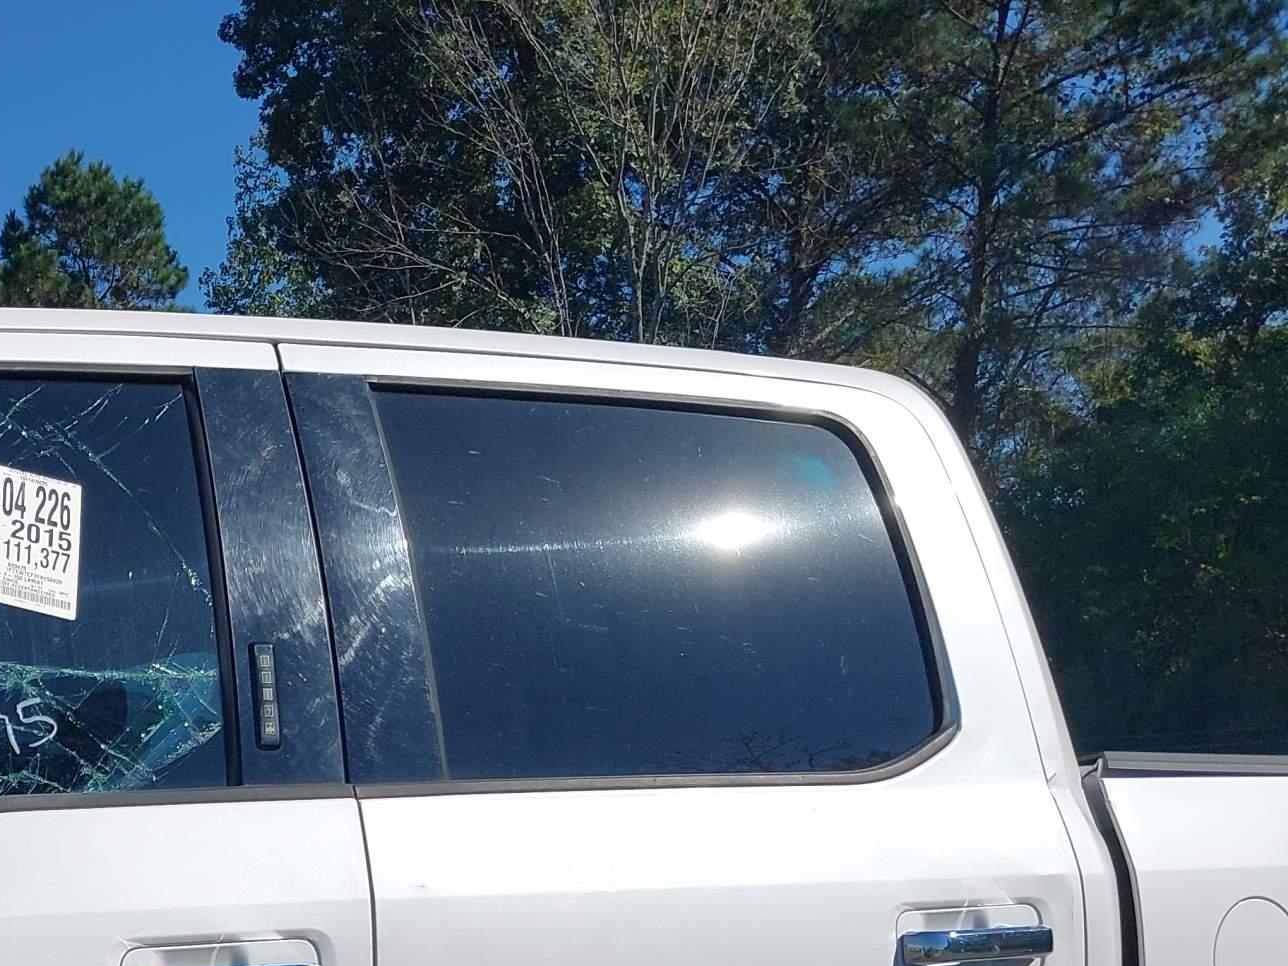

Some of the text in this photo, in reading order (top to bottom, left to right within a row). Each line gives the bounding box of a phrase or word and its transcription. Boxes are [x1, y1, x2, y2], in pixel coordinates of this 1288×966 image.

[2, 477, 26, 519] 04
[34, 486, 71, 531] 226
[10, 519, 72, 551] 2015
[3, 539, 70, 573] 111,377
